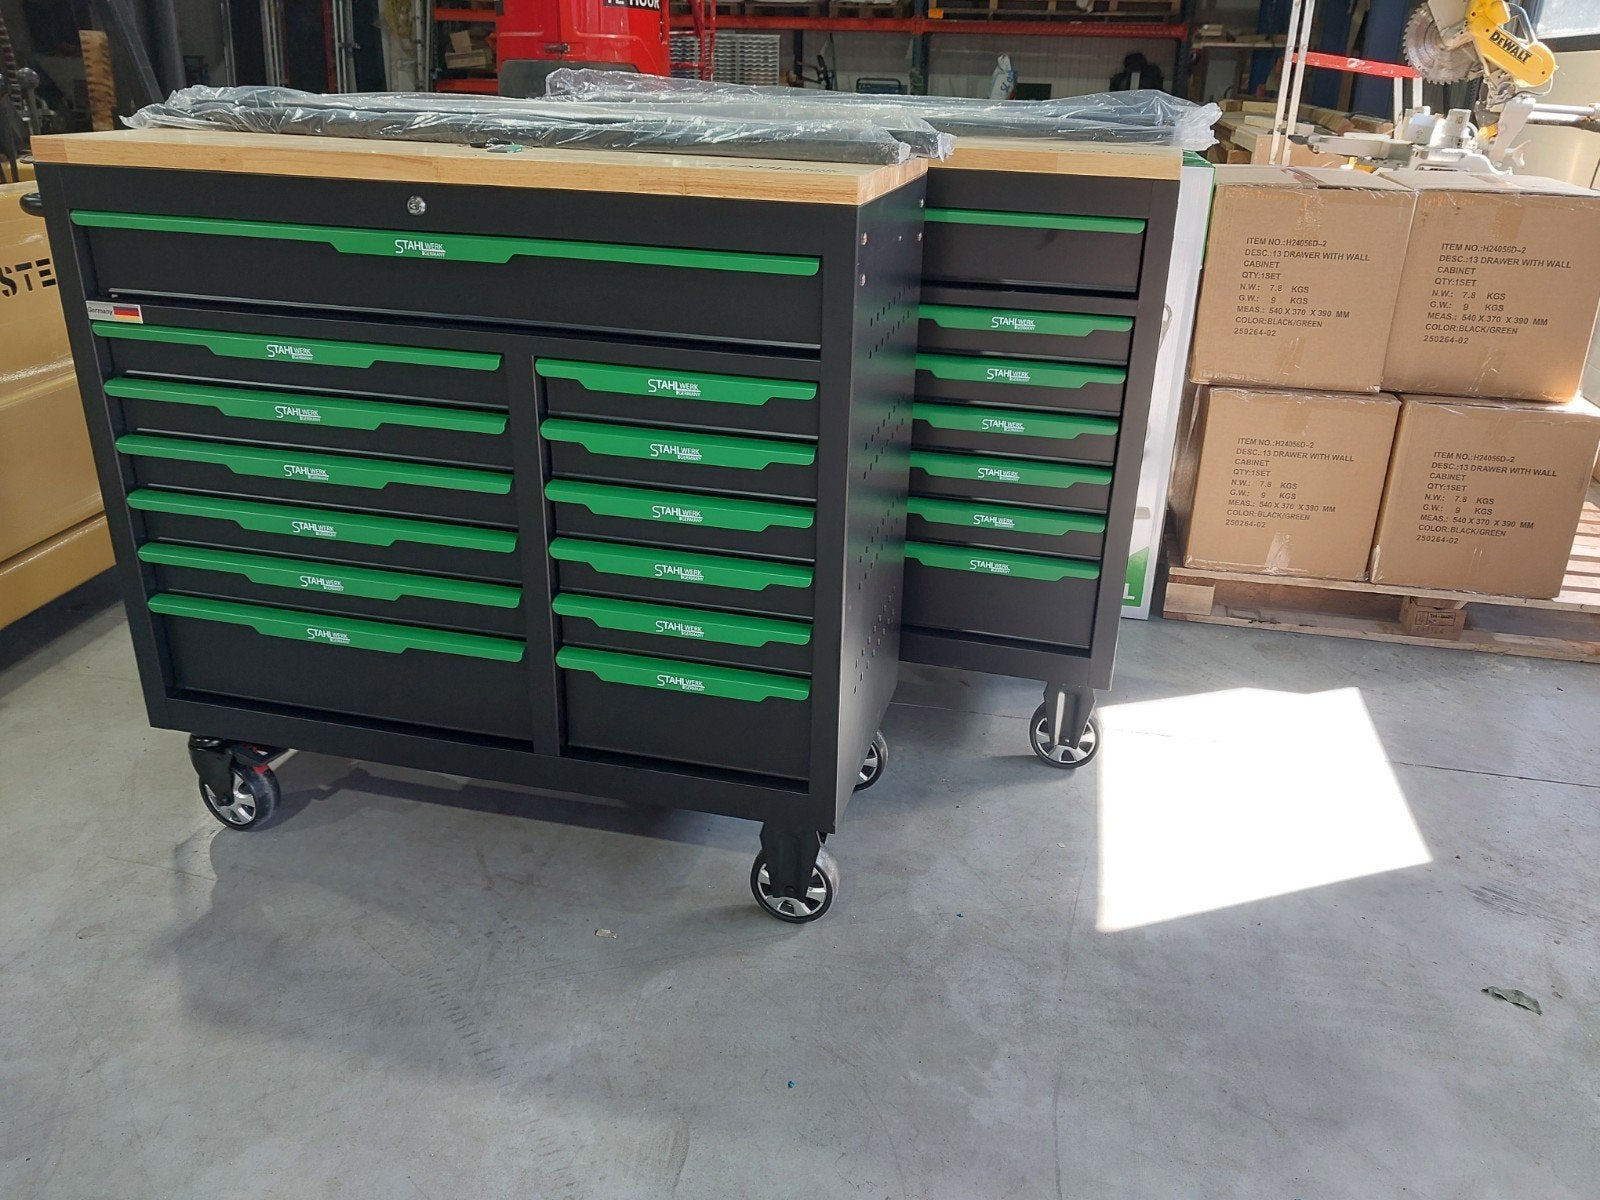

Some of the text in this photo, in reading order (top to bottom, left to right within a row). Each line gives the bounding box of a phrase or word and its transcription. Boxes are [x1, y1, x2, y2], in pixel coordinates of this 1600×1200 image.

[1489, 31, 1533, 63] DEWALT
[1442, 243, 1462, 251] ITEM
[1284, 251, 1320, 259] DRAWER
[1322, 252, 1343, 260] WITH
[1244, 260, 1280, 268] CABINET
[1481, 257, 1519, 265] DRAWER
[1522, 259, 1544, 267] WITH
[1546, 260, 1571, 268] WALL
[1234, 328, 1276, 336] 250264-02
[1423, 335, 1468, 344] 250264-02
[1273, 450, 1307, 459] DRAWER
[1470, 465, 1507, 473] DRAWER
[1509, 467, 1531, 475] WITH
[1533, 469, 1557, 477] WALL
[1430, 473, 1466, 481] CABINET
[1225, 519, 1266, 528] 250264-02
[1520, 521, 1535, 529] MM
[1416, 535, 1458, 544] 250264-02
